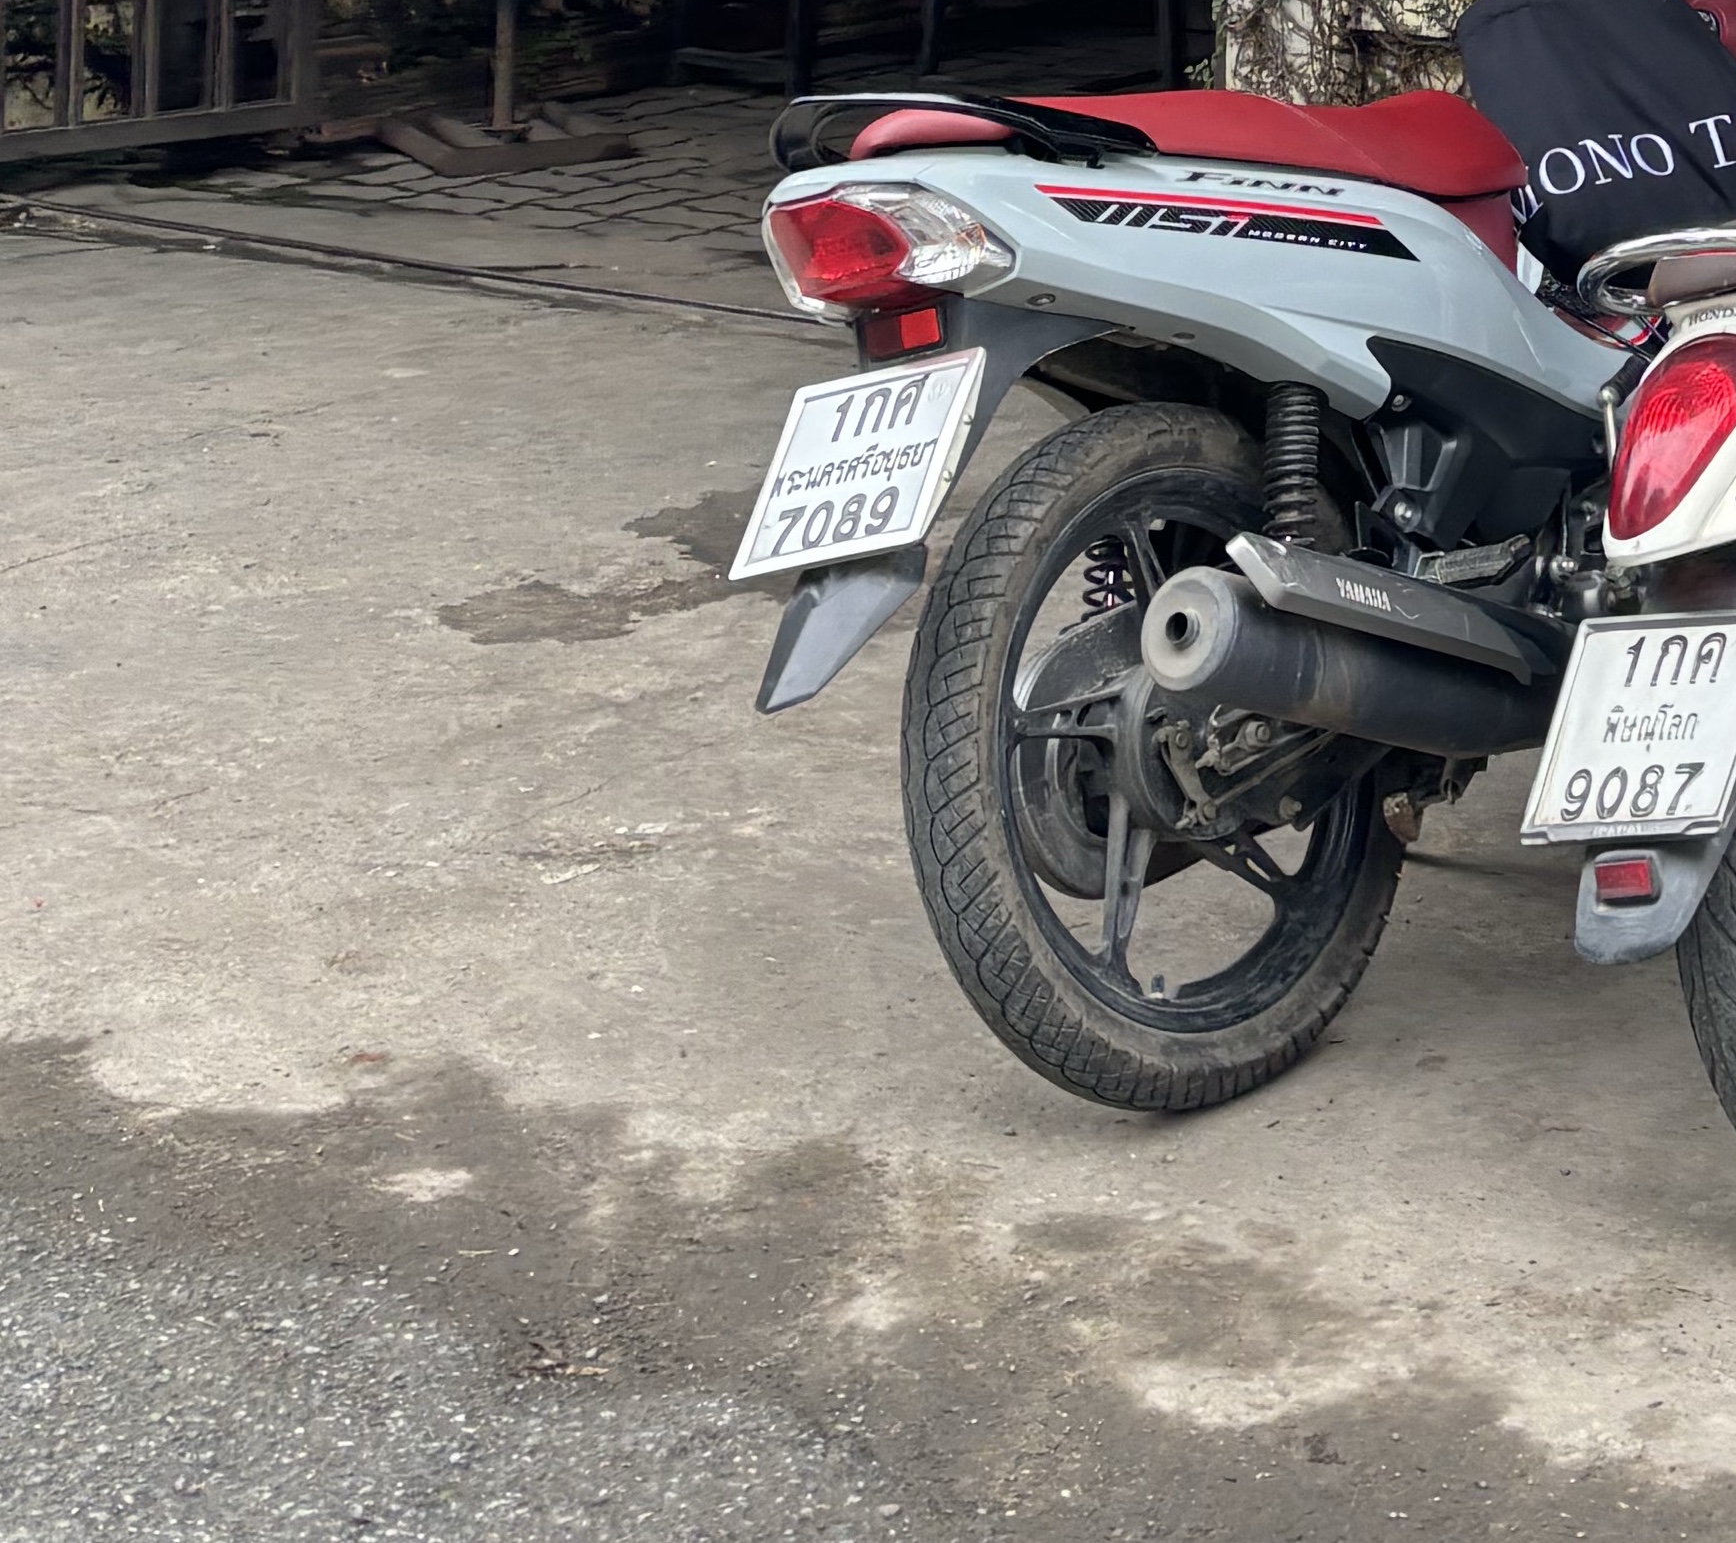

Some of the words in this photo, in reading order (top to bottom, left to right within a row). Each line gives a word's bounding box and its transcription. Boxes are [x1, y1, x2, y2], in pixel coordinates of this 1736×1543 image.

[770, 486, 900, 557] 7089
[1335, 577, 1392, 612] YAMAHA
[1623, 632, 1727, 687] 1กค
[1603, 704, 1699, 752] พิษณุโลก
[1560, 761, 1705, 822] 9087
